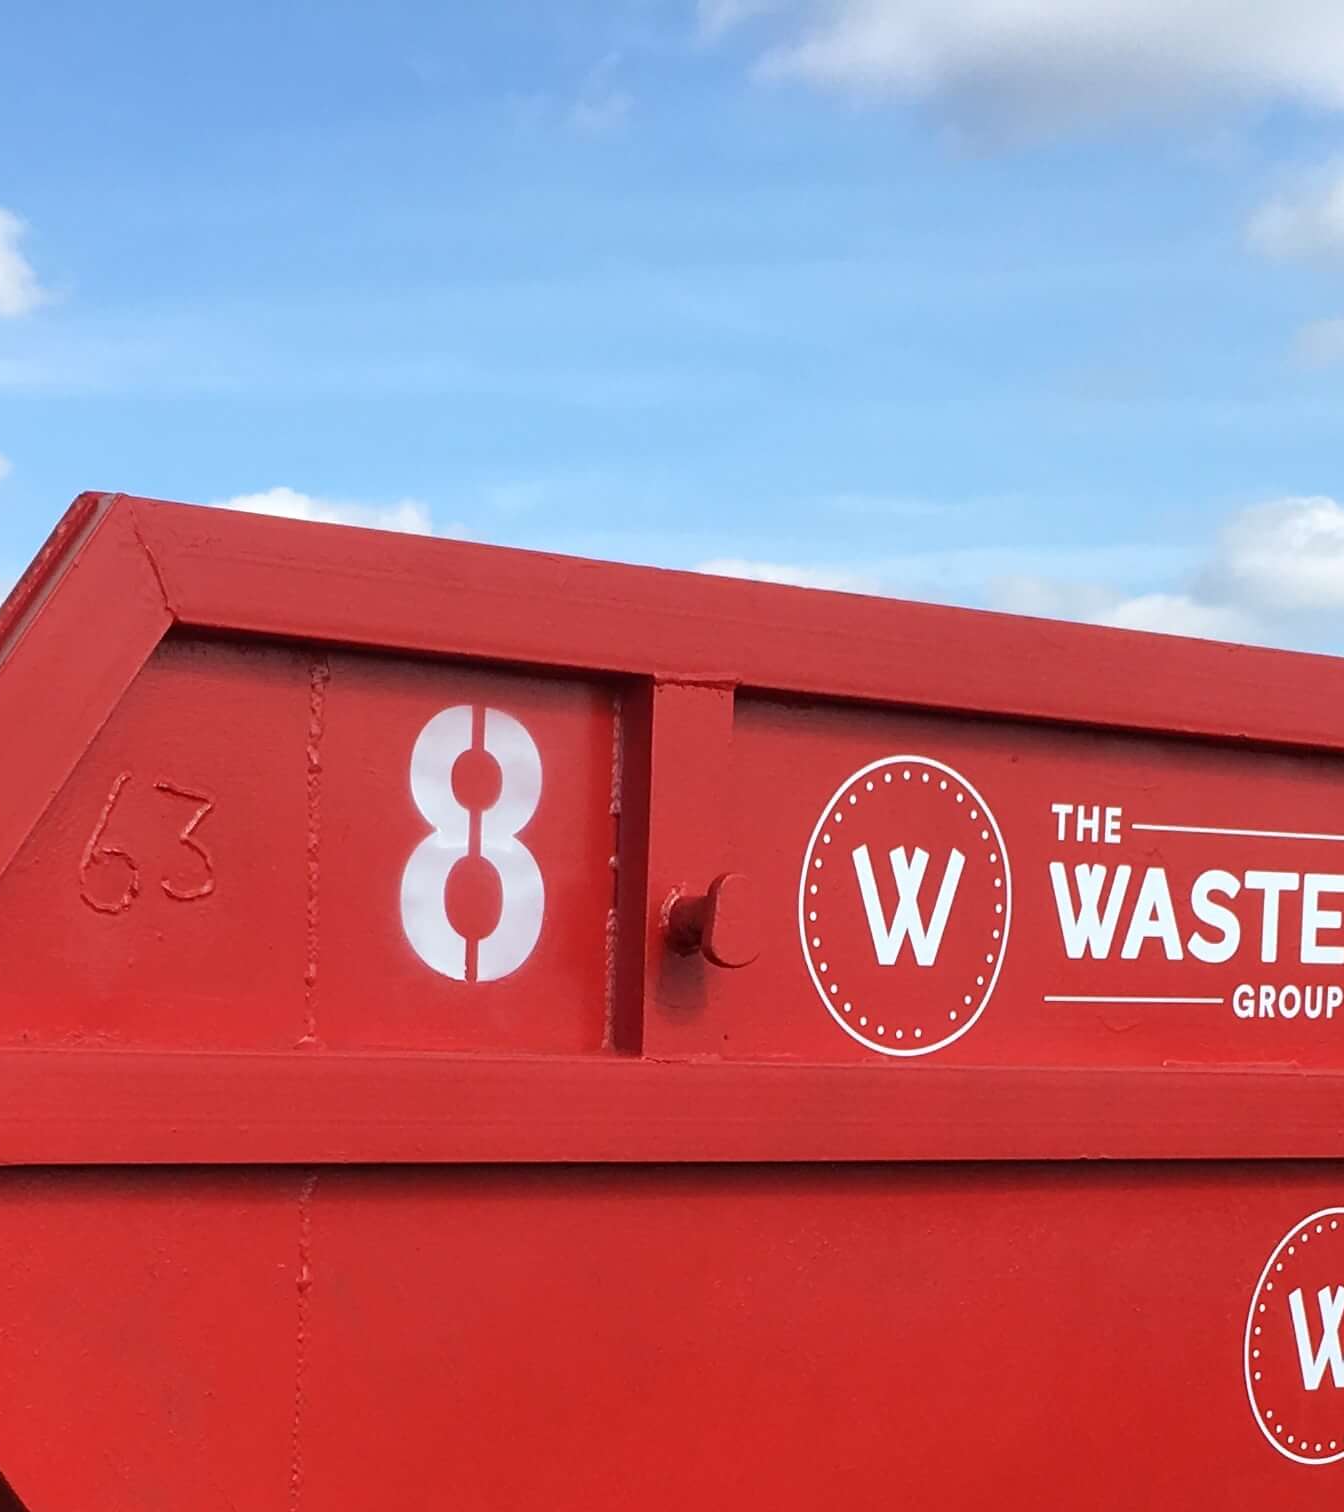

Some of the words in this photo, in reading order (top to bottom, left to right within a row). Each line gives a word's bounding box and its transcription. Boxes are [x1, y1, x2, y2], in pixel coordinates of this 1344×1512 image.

[79, 772, 214, 915] 63
[399, 704, 546, 983] 8
[1051, 803, 1123, 844] THE
[851, 843, 966, 967] W
[1232, 983, 1344, 1019] GROUP
